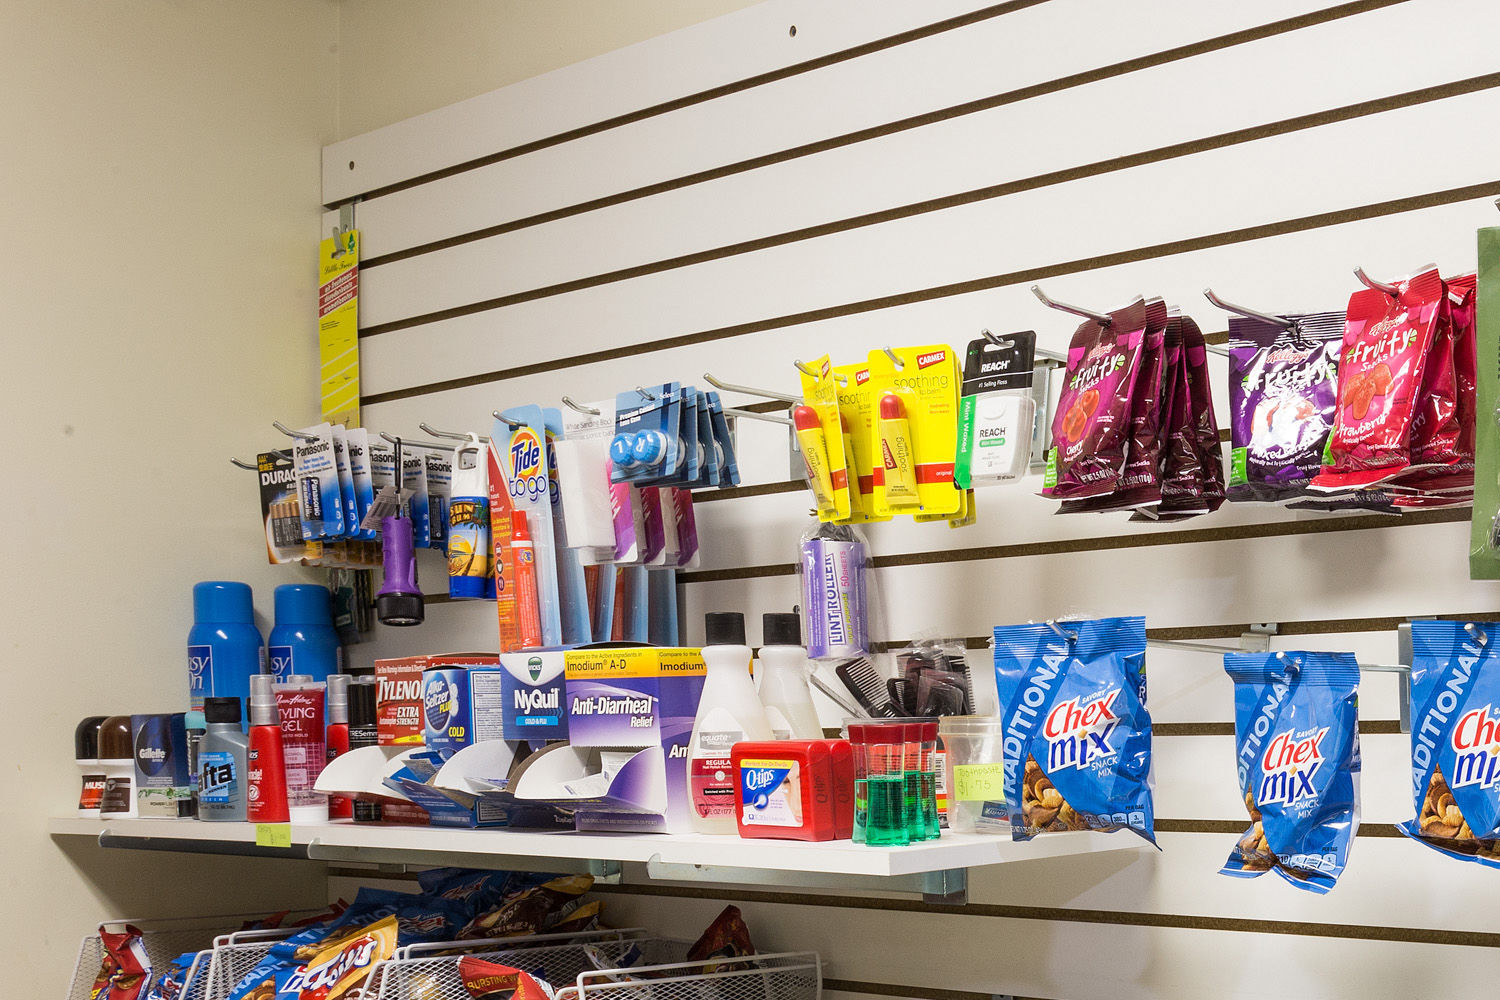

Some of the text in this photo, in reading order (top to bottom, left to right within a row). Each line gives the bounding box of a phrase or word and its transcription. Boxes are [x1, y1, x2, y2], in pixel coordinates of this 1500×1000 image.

[1353, 328, 1413, 363] fruity
[918, 352, 945, 365] CARMEX
[981, 361, 1009, 373] REACH
[1075, 353, 1121, 389] fruity
[894, 374, 949, 389] soothing
[961, 422, 970, 453] Waxed
[979, 427, 1006, 438] REACH
[296, 440, 330, 457] Panasonic
[511, 440, 541, 479] Tide
[509, 477, 527, 499] to
[527, 474, 547, 501] go
[828, 613, 843, 643] LINT
[610, 659, 627, 670] A-D
[426, 680, 445, 696] Alka-
[425, 691, 450, 710] Seltzer
[514, 689, 559, 715] NyQuil
[571, 696, 652, 716] Anti-Diarrheal
[397, 706, 420, 718] EXTRA
[1043, 689, 1120, 739] Chex
[281, 720, 303, 732] GEL
[396, 717, 420, 726] STRENGTH
[630, 716, 653, 728] Relief
[448, 727, 465, 737] COLD
[138, 748, 166, 760] Gillette
[1049, 725, 1116, 770] mix
[1262, 729, 1321, 771] Chex
[1091, 756, 1118, 771] SNACK
[746, 769, 775, 790] Q-tips
[1260, 761, 1321, 804] mix
[467, 975, 508, 990] BURSTING
